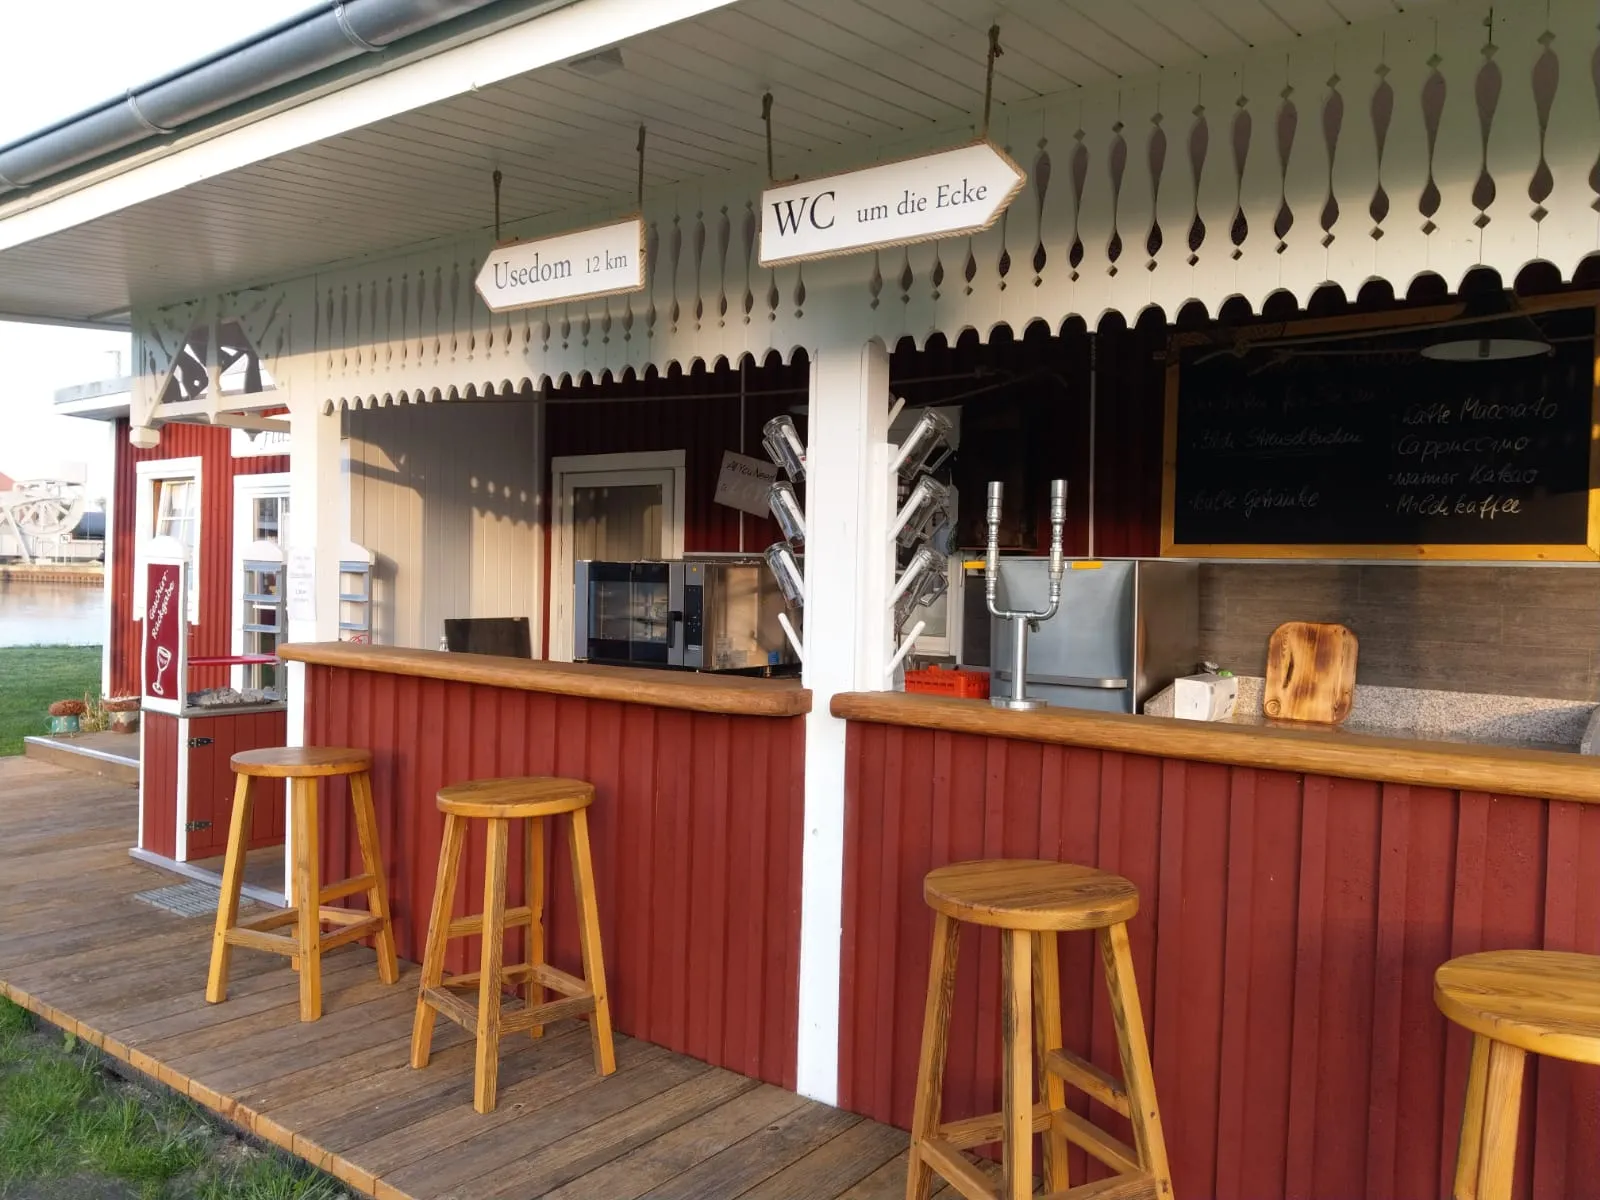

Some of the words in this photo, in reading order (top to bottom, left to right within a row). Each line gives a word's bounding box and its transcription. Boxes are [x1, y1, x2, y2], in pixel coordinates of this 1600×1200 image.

[771, 191, 835, 237] WC
[856, 203, 889, 223] um
[896, 190, 928, 216] die
[935, 178, 988, 209] Ecke
[493, 252, 572, 290] Usedom
[586, 255, 600, 274] 12
[605, 250, 628, 270] km
